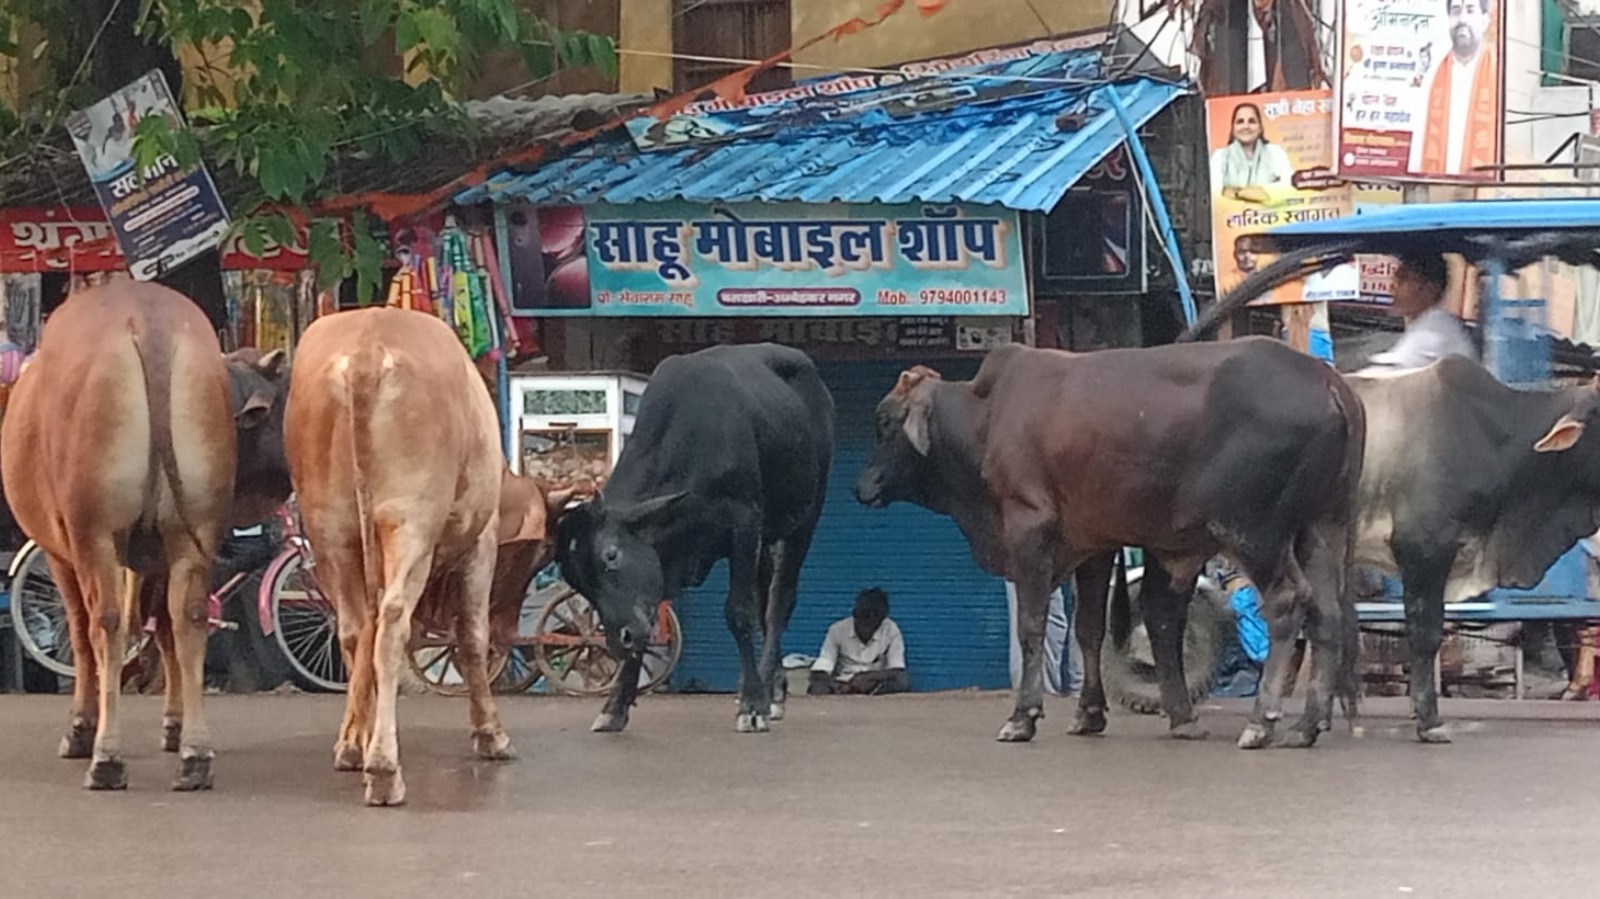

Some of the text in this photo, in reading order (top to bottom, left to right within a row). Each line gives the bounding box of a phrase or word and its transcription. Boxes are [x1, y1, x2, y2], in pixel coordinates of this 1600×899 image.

[590, 207, 999, 280] साहू मोबाइल शॉप
[827, 293, 856, 303] नगर
[919, 290, 1006, 305] 9794001143
